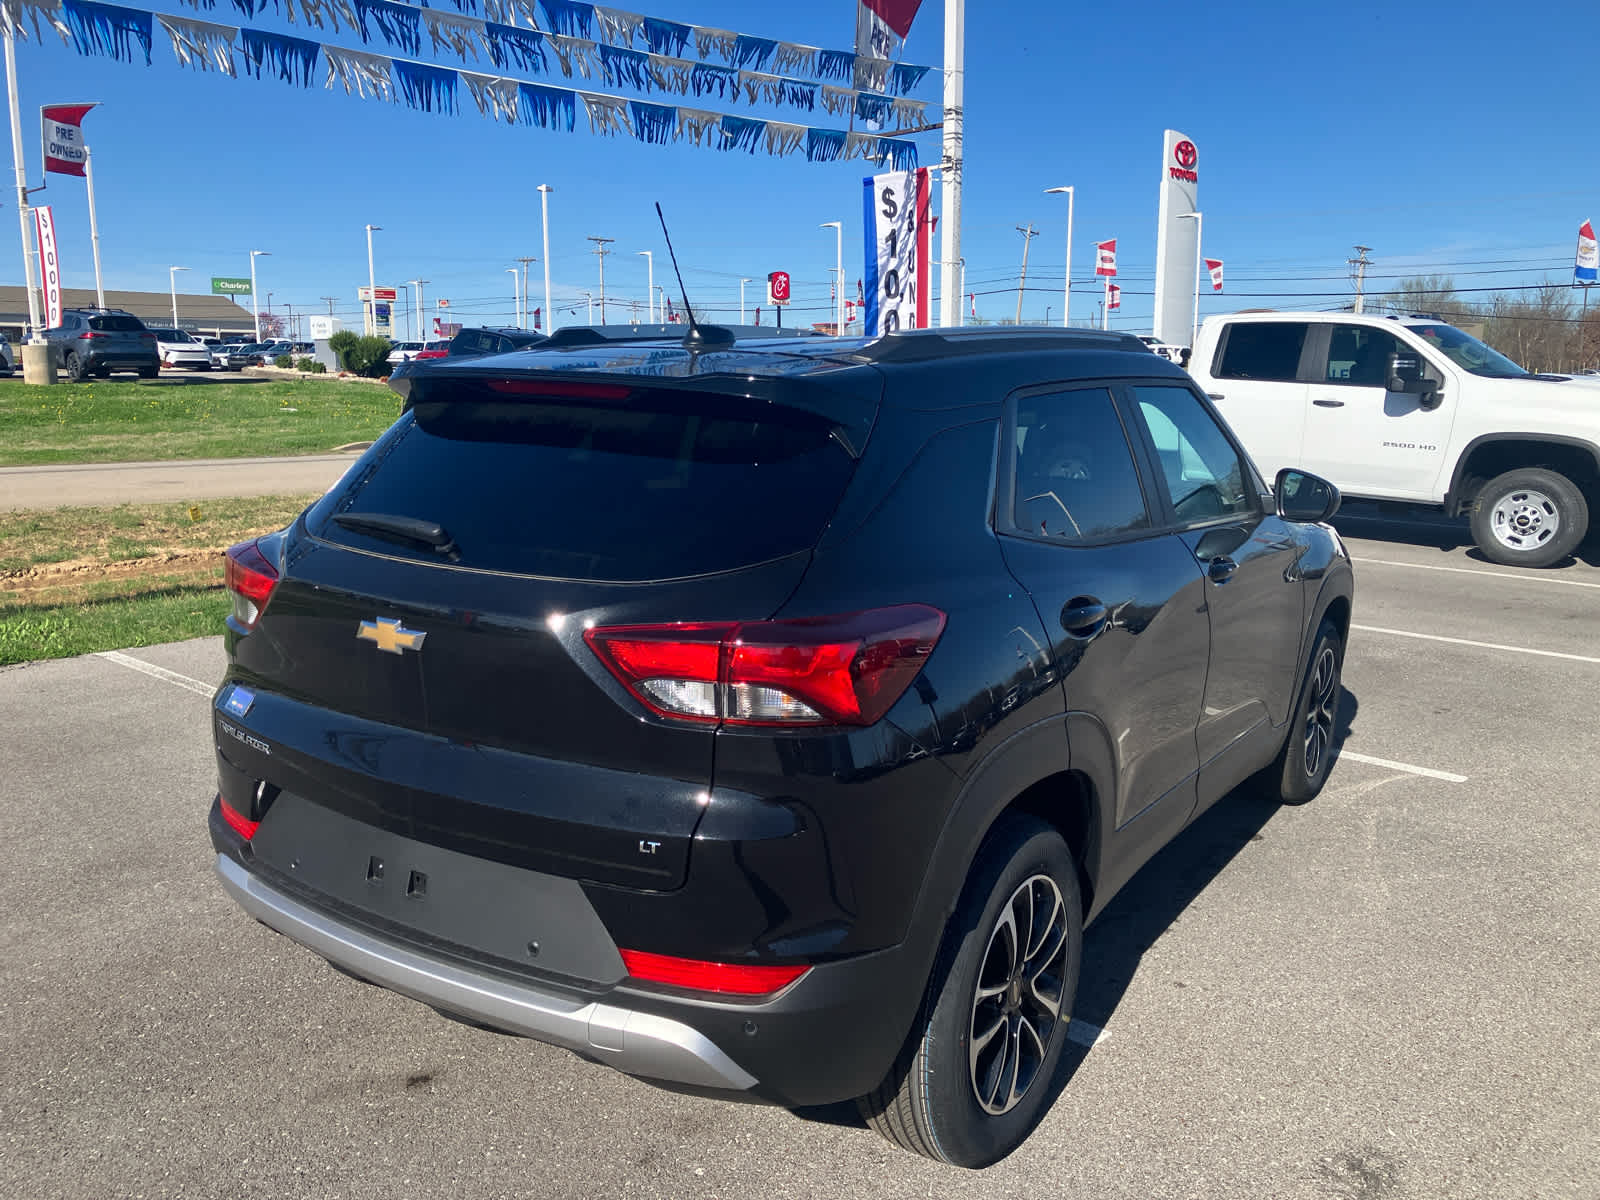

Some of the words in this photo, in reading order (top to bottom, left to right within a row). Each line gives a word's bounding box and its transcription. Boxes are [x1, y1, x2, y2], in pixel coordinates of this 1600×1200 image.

[55, 126, 74, 140] PRE
[49, 142, 82, 159] OWNED
[1169, 167, 1198, 184] TOYOTA
[1383, 441, 1416, 449] 2500
[219, 720, 271, 755] TRAILBLAZER
[639, 840, 661, 854] LT
